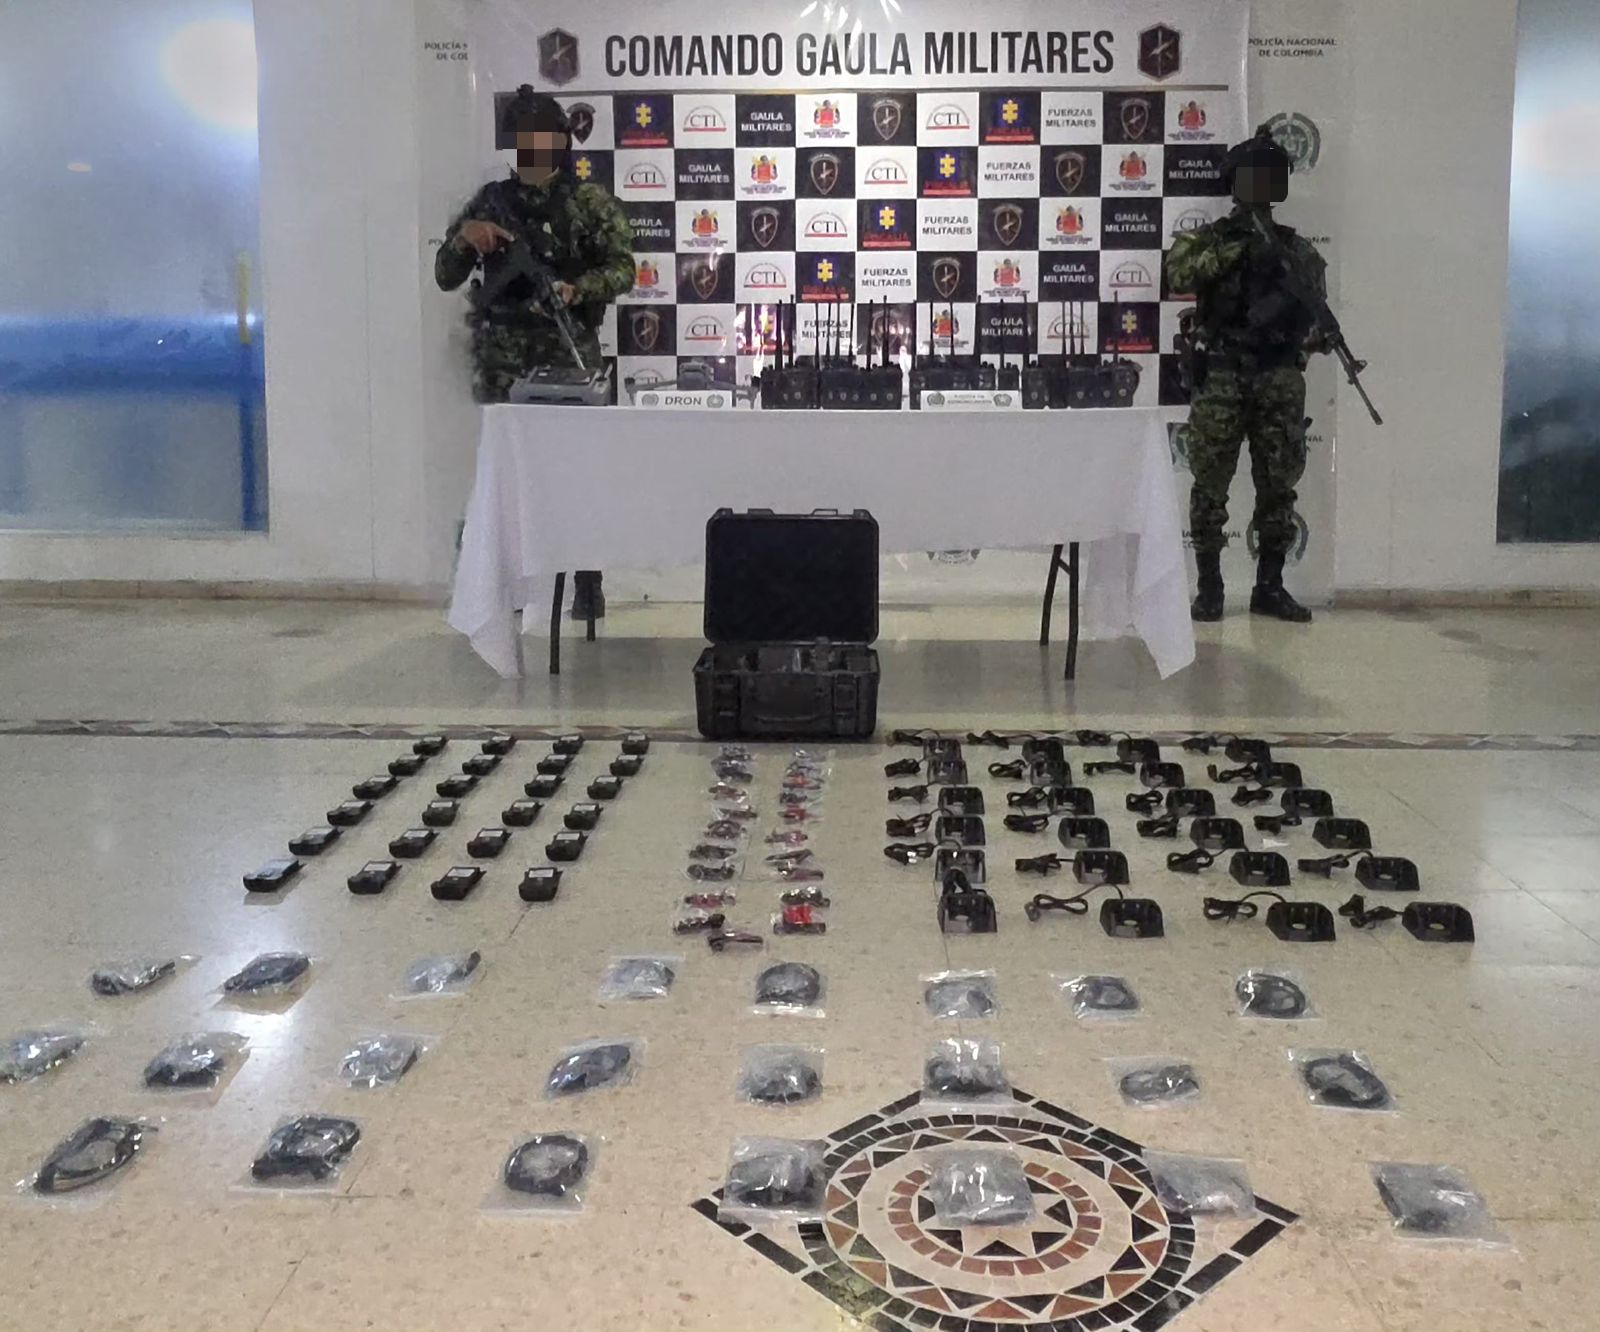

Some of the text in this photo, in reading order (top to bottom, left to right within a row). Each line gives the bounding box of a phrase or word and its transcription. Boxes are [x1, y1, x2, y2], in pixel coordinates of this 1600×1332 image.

[605, 30, 1114, 77] COMANDO GAULA MILITARES
[1259, 49, 1271, 57] DE
[750, 112, 783, 121] GAULA
[1048, 109, 1093, 117] FUERZAS
[690, 115, 717, 127] CTI
[933, 113, 960, 125] CTI
[1045, 119, 1096, 127] MILITARES
[741, 123, 792, 132] MILITARES
[688, 164, 721, 172] GAULA
[986, 162, 1031, 170] FUERZAS
[1178, 160, 1212, 168] GAULA
[631, 172, 656, 184] CTI
[679, 174, 730, 183] MILITARES
[871, 168, 897, 180] CTI
[984, 172, 1035, 181] MILITARES
[1168, 170, 1220, 179] MILITARES
[630, 218, 662, 226] GAULA
[924, 216, 969, 224] FUERZAS
[1115, 213, 1148, 222] GAULA
[811, 221, 838, 233] CTI
[922, 226, 972, 235] MILITARES
[1105, 223, 1157, 232] MILITARES
[863, 268, 908, 276] FUERZAS
[1053, 264, 1087, 273] GAULA
[751, 271, 777, 283] CTI
[1043, 274, 1095, 283] MILITARES
[1115, 271, 1142, 283] CTI
[861, 278, 911, 287] MILITARES
[691, 324, 718, 336] CTI
[664, 396, 702, 405] DRON
